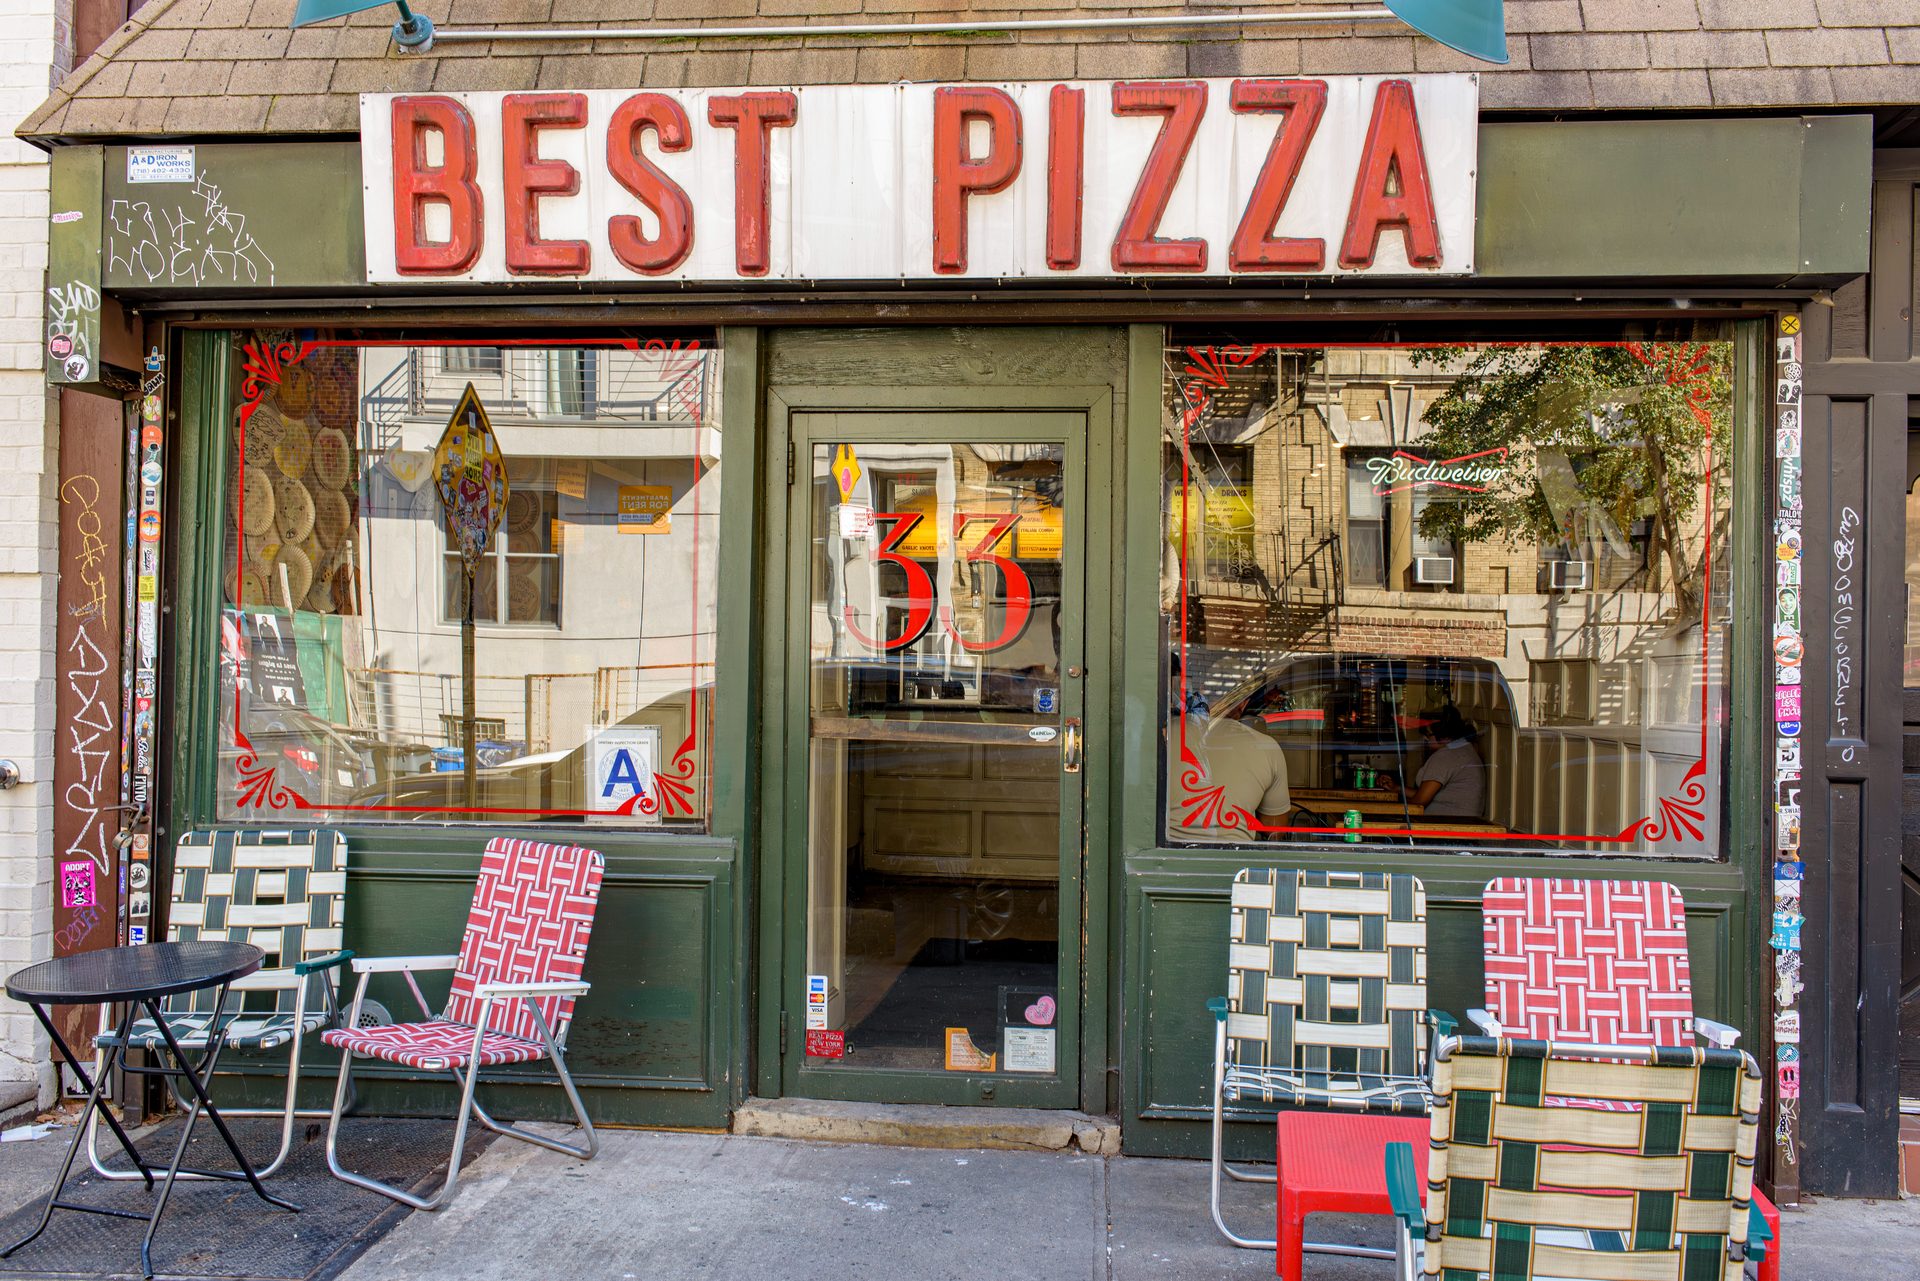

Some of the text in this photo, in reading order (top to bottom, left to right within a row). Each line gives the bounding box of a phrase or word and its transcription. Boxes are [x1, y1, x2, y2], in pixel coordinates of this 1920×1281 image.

[131, 155, 139, 165] A
[147, 155, 155, 165] D
[391, 92, 798, 277] BEST
[933, 79, 1444, 275] PIZZA
[1366, 457, 1506, 486] Budweiser
[1221, 489, 1247, 497] DRINKS
[844, 512, 1035, 654] 33
[602, 749, 645, 797] A
[135, 775, 148, 802] PINTO
[65, 863, 91, 872] ADOPT
[825, 1032, 843, 1041] PIZZA
